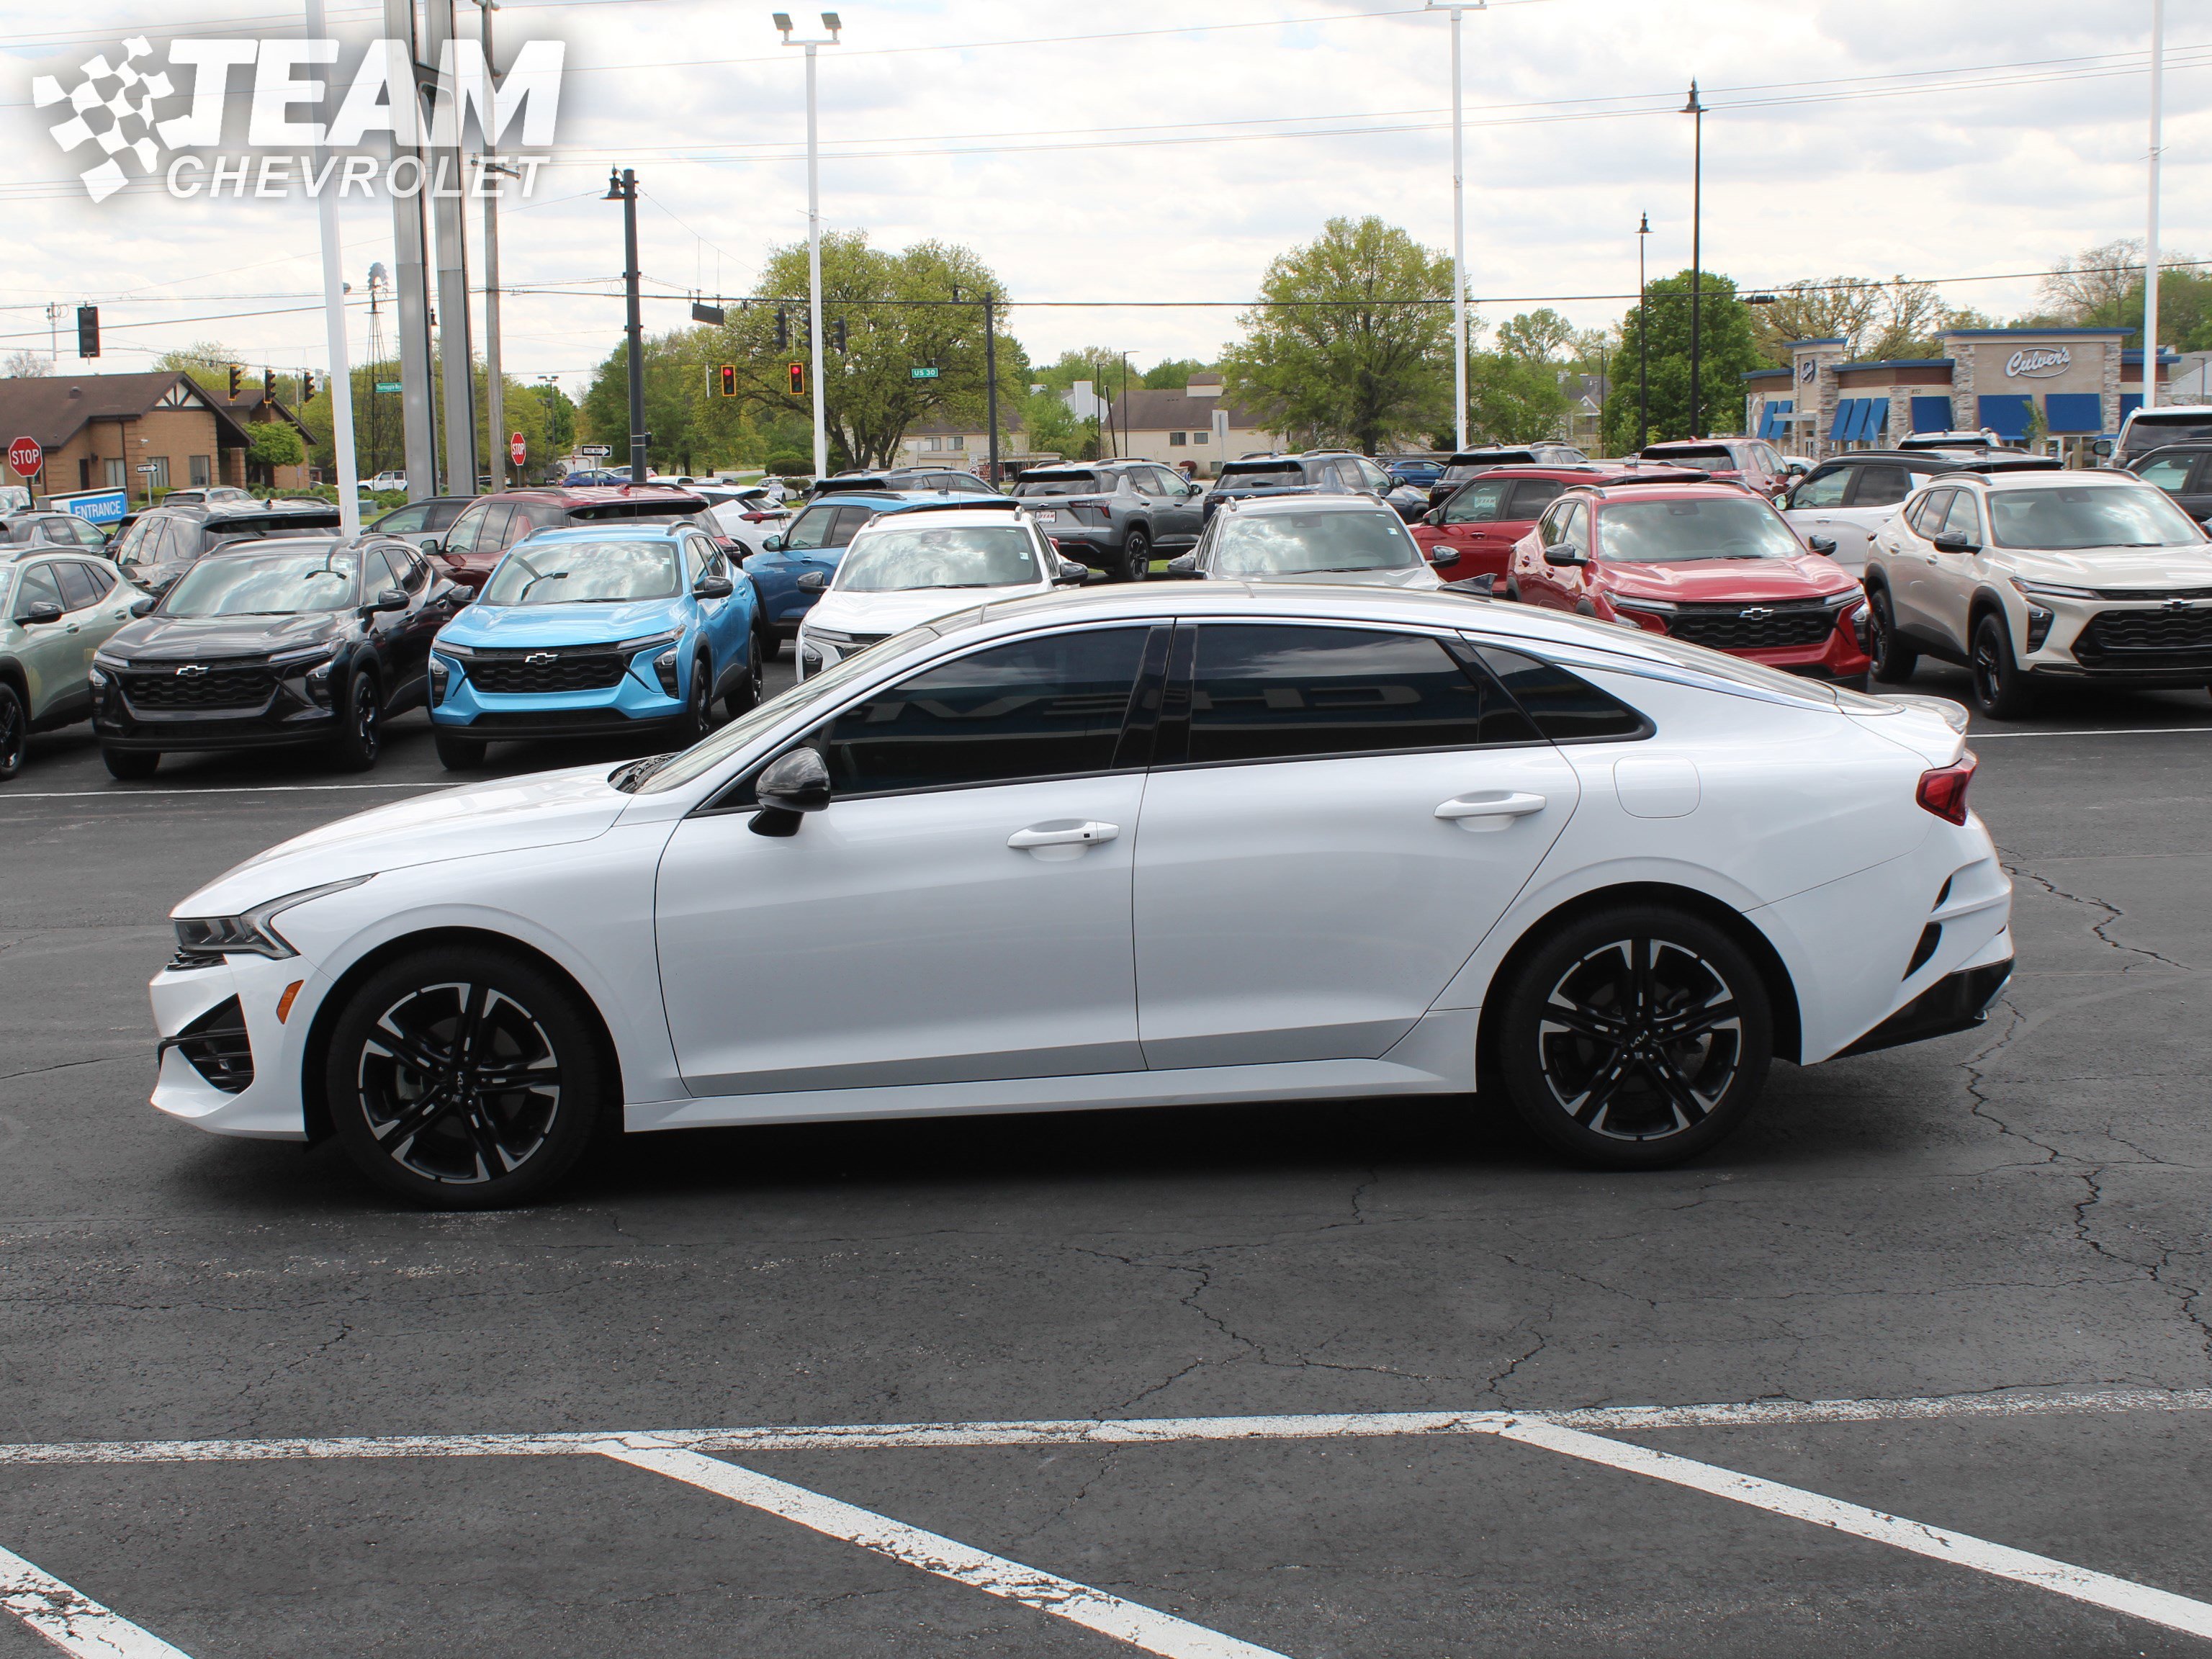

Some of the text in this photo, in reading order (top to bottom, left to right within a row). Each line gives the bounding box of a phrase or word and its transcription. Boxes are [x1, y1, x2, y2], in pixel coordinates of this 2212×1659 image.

[2005, 346, 2072, 377] Culver's
[11, 449, 40, 465] STOP
[512, 443, 525, 455] STOP
[74, 500, 122, 520] ENTRANCE
